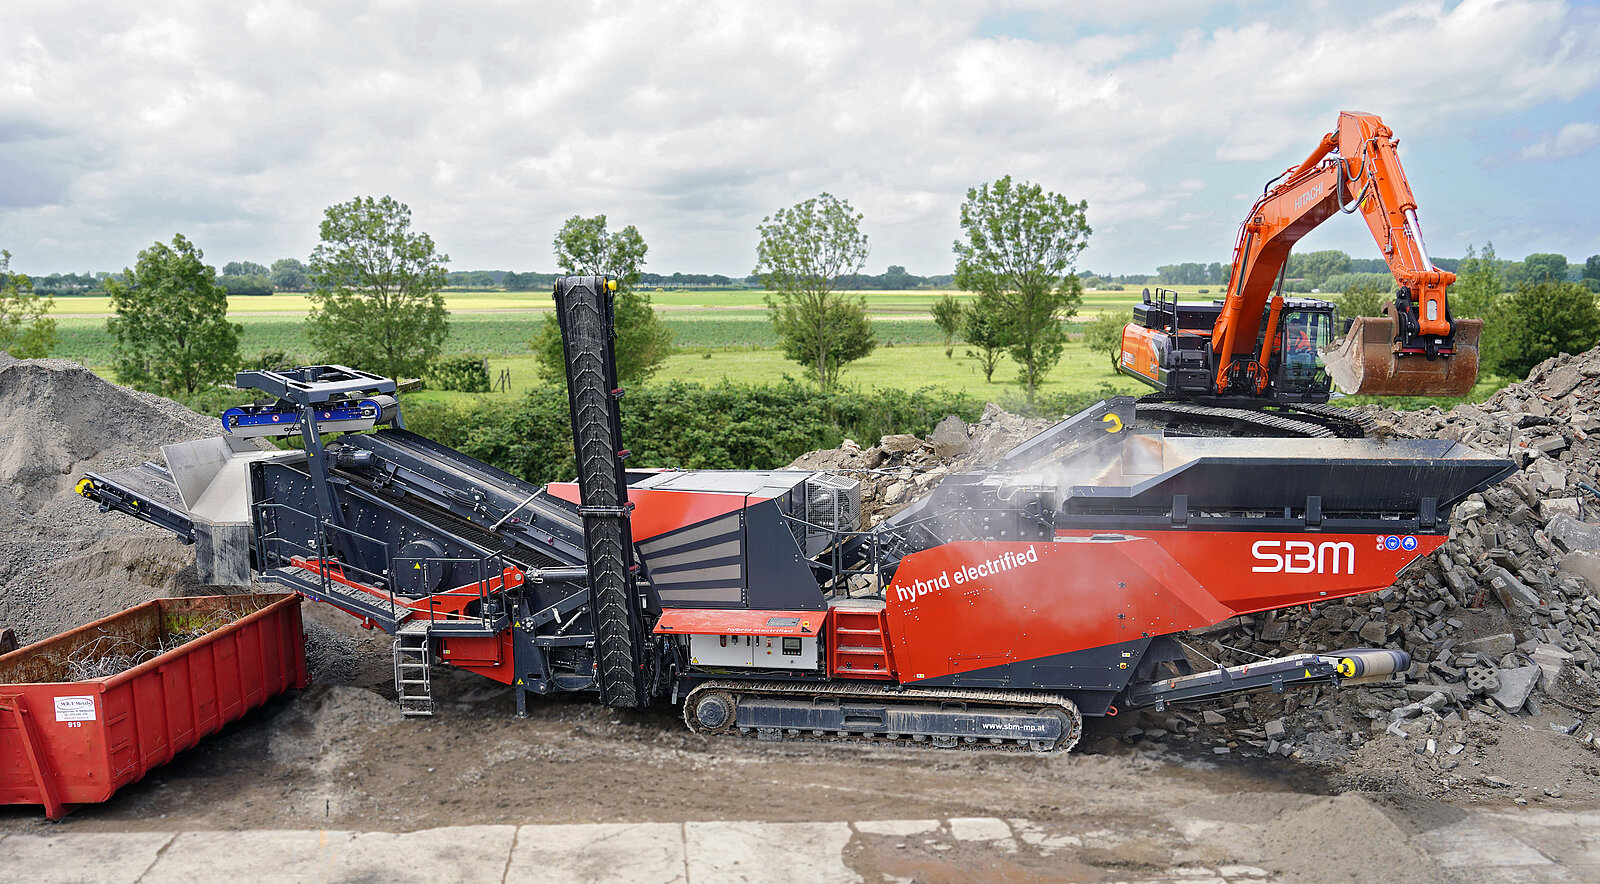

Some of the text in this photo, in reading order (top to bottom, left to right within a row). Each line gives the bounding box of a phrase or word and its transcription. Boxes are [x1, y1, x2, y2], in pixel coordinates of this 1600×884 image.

[1294, 181, 1324, 211] HITACHI
[895, 545, 1038, 602] hybrid electrified
[1251, 540, 1355, 575] SBM
[982, 723, 1045, 732] www.sbm-mp.at
